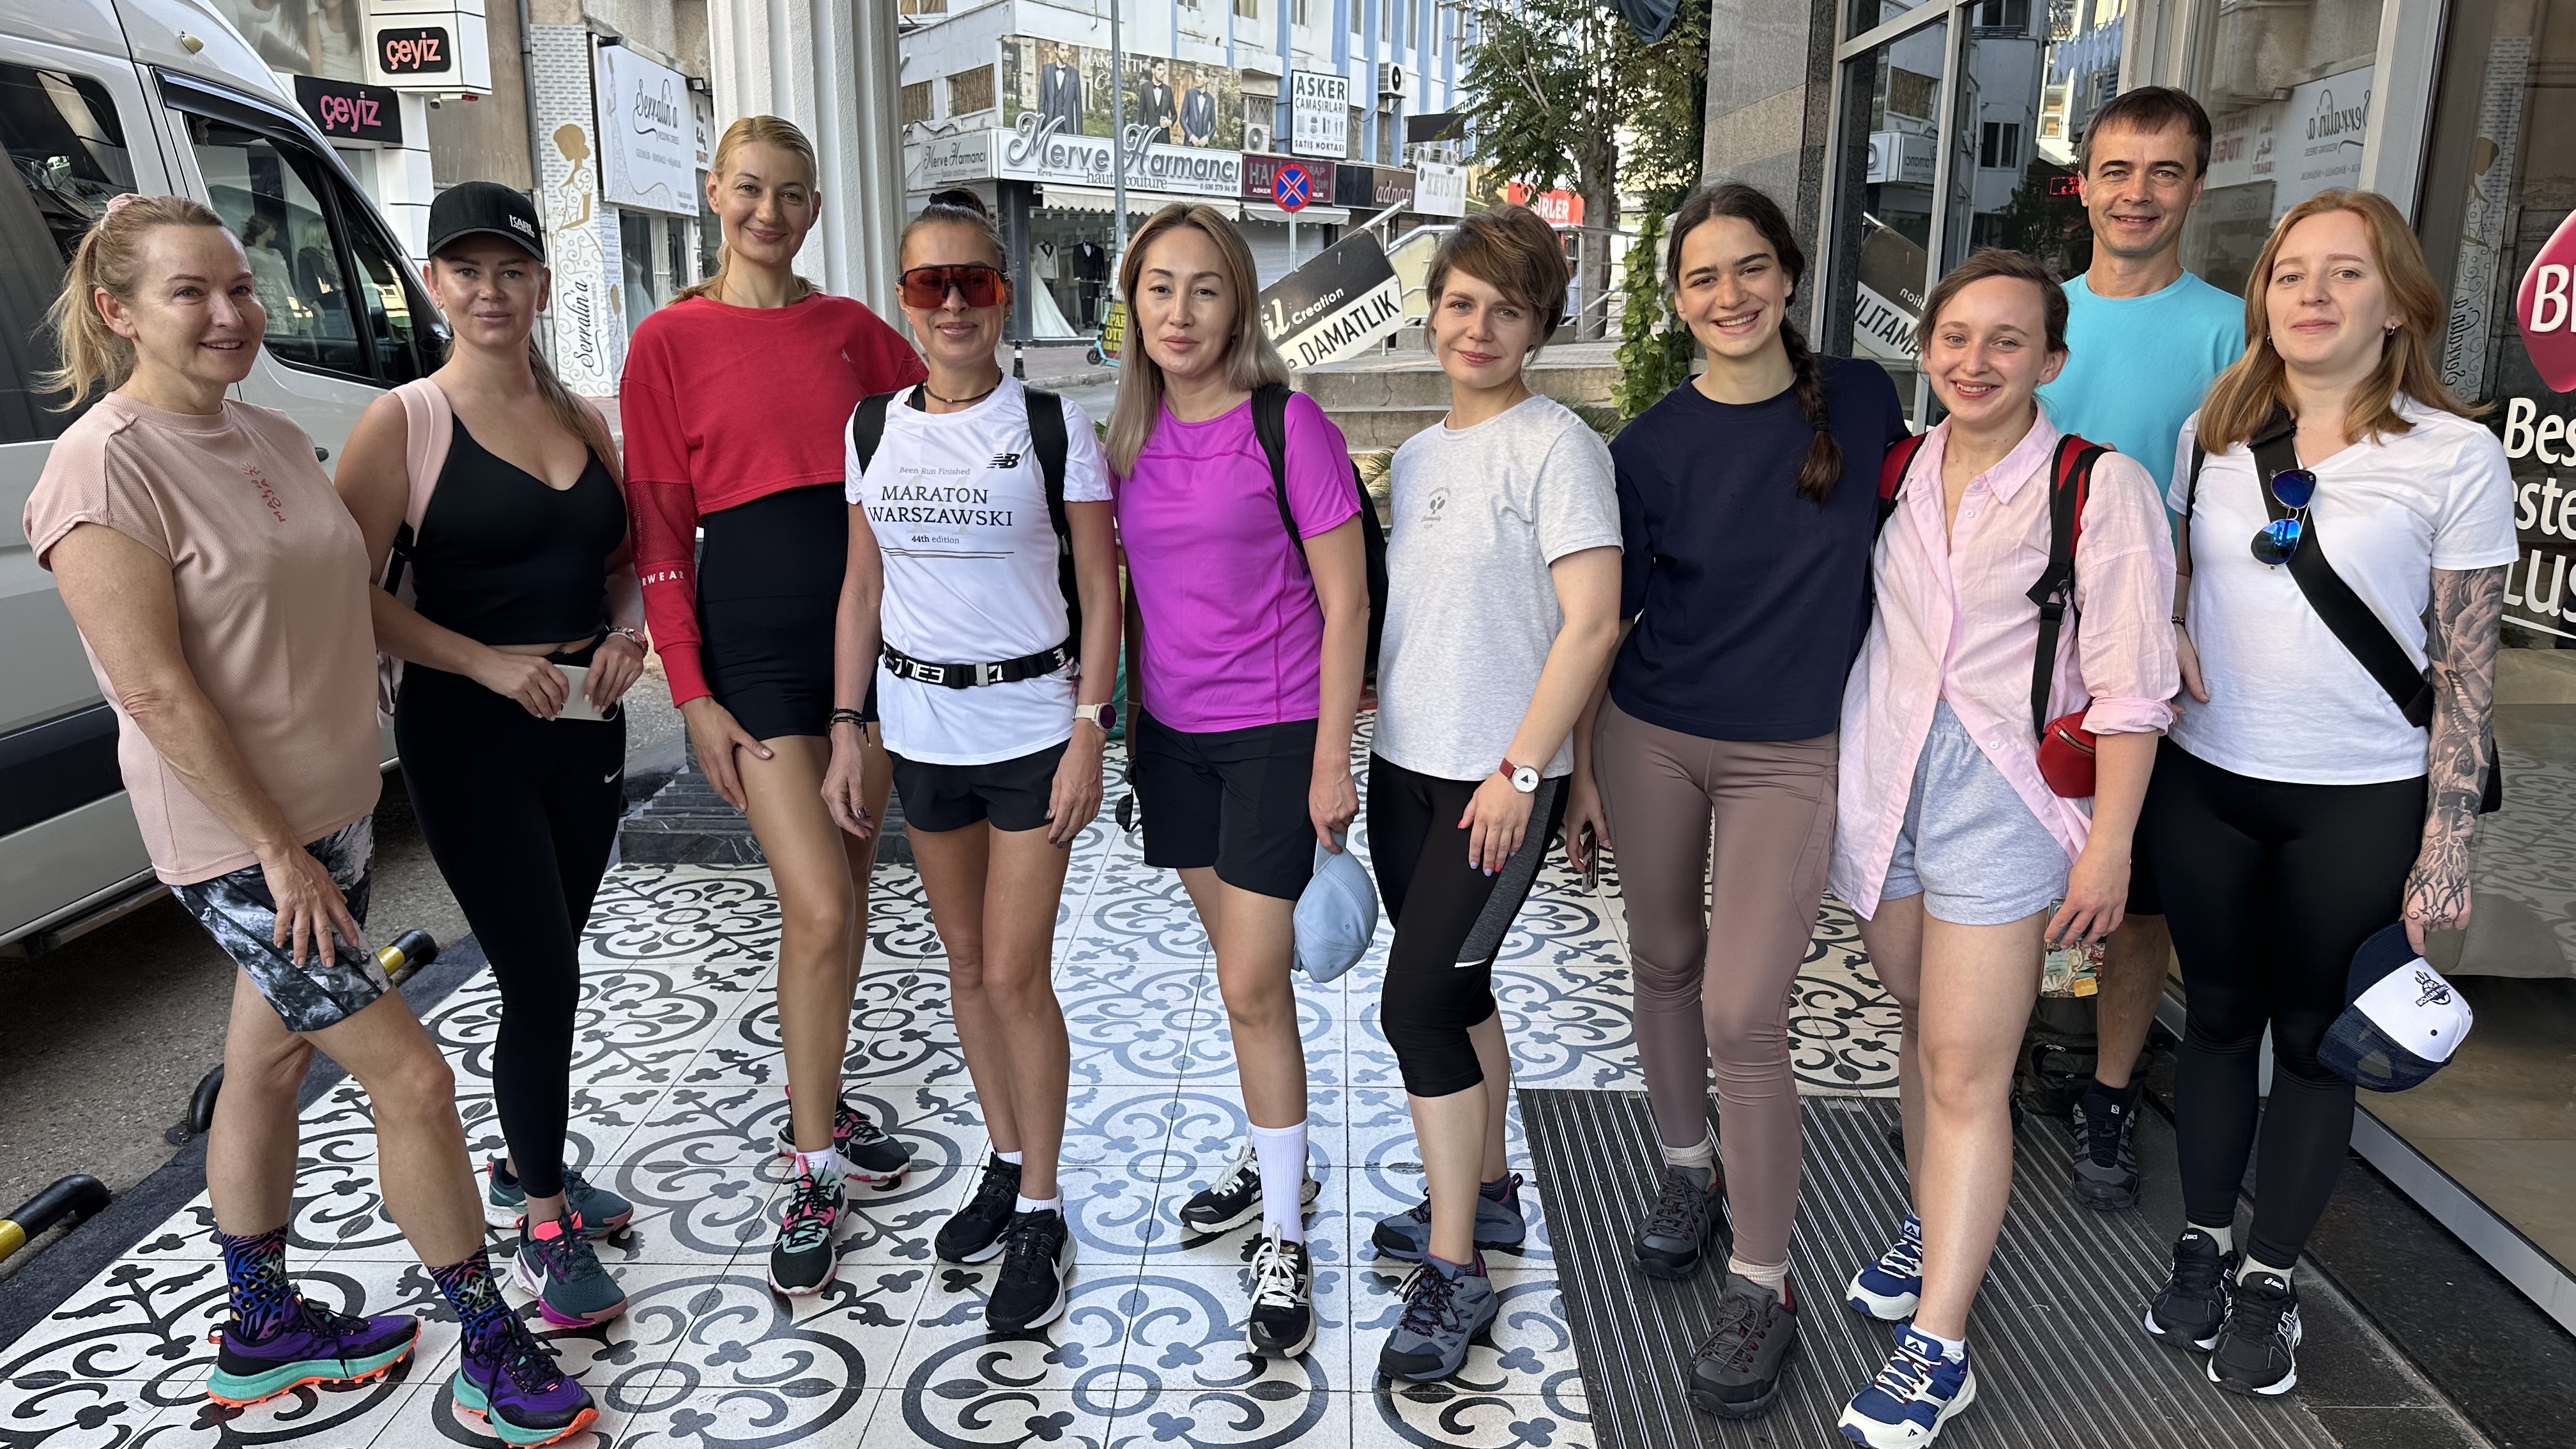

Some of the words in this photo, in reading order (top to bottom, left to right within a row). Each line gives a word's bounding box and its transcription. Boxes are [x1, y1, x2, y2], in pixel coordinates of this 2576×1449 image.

[386, 31, 441, 70] çeyiz
[1296, 75, 1345, 100] ASKER
[320, 91, 382, 133] çeyiz
[1006, 111, 1112, 172] Merve
[1295, 139, 1314, 151] SATIŞ
[1086, 167, 1116, 185] haut
[1298, 289, 1400, 367] DAMATLIK
[881, 485, 989, 504] MARATON
[868, 507, 1013, 526] WARSZAWSKI
[931, 535, 960, 544] edition
